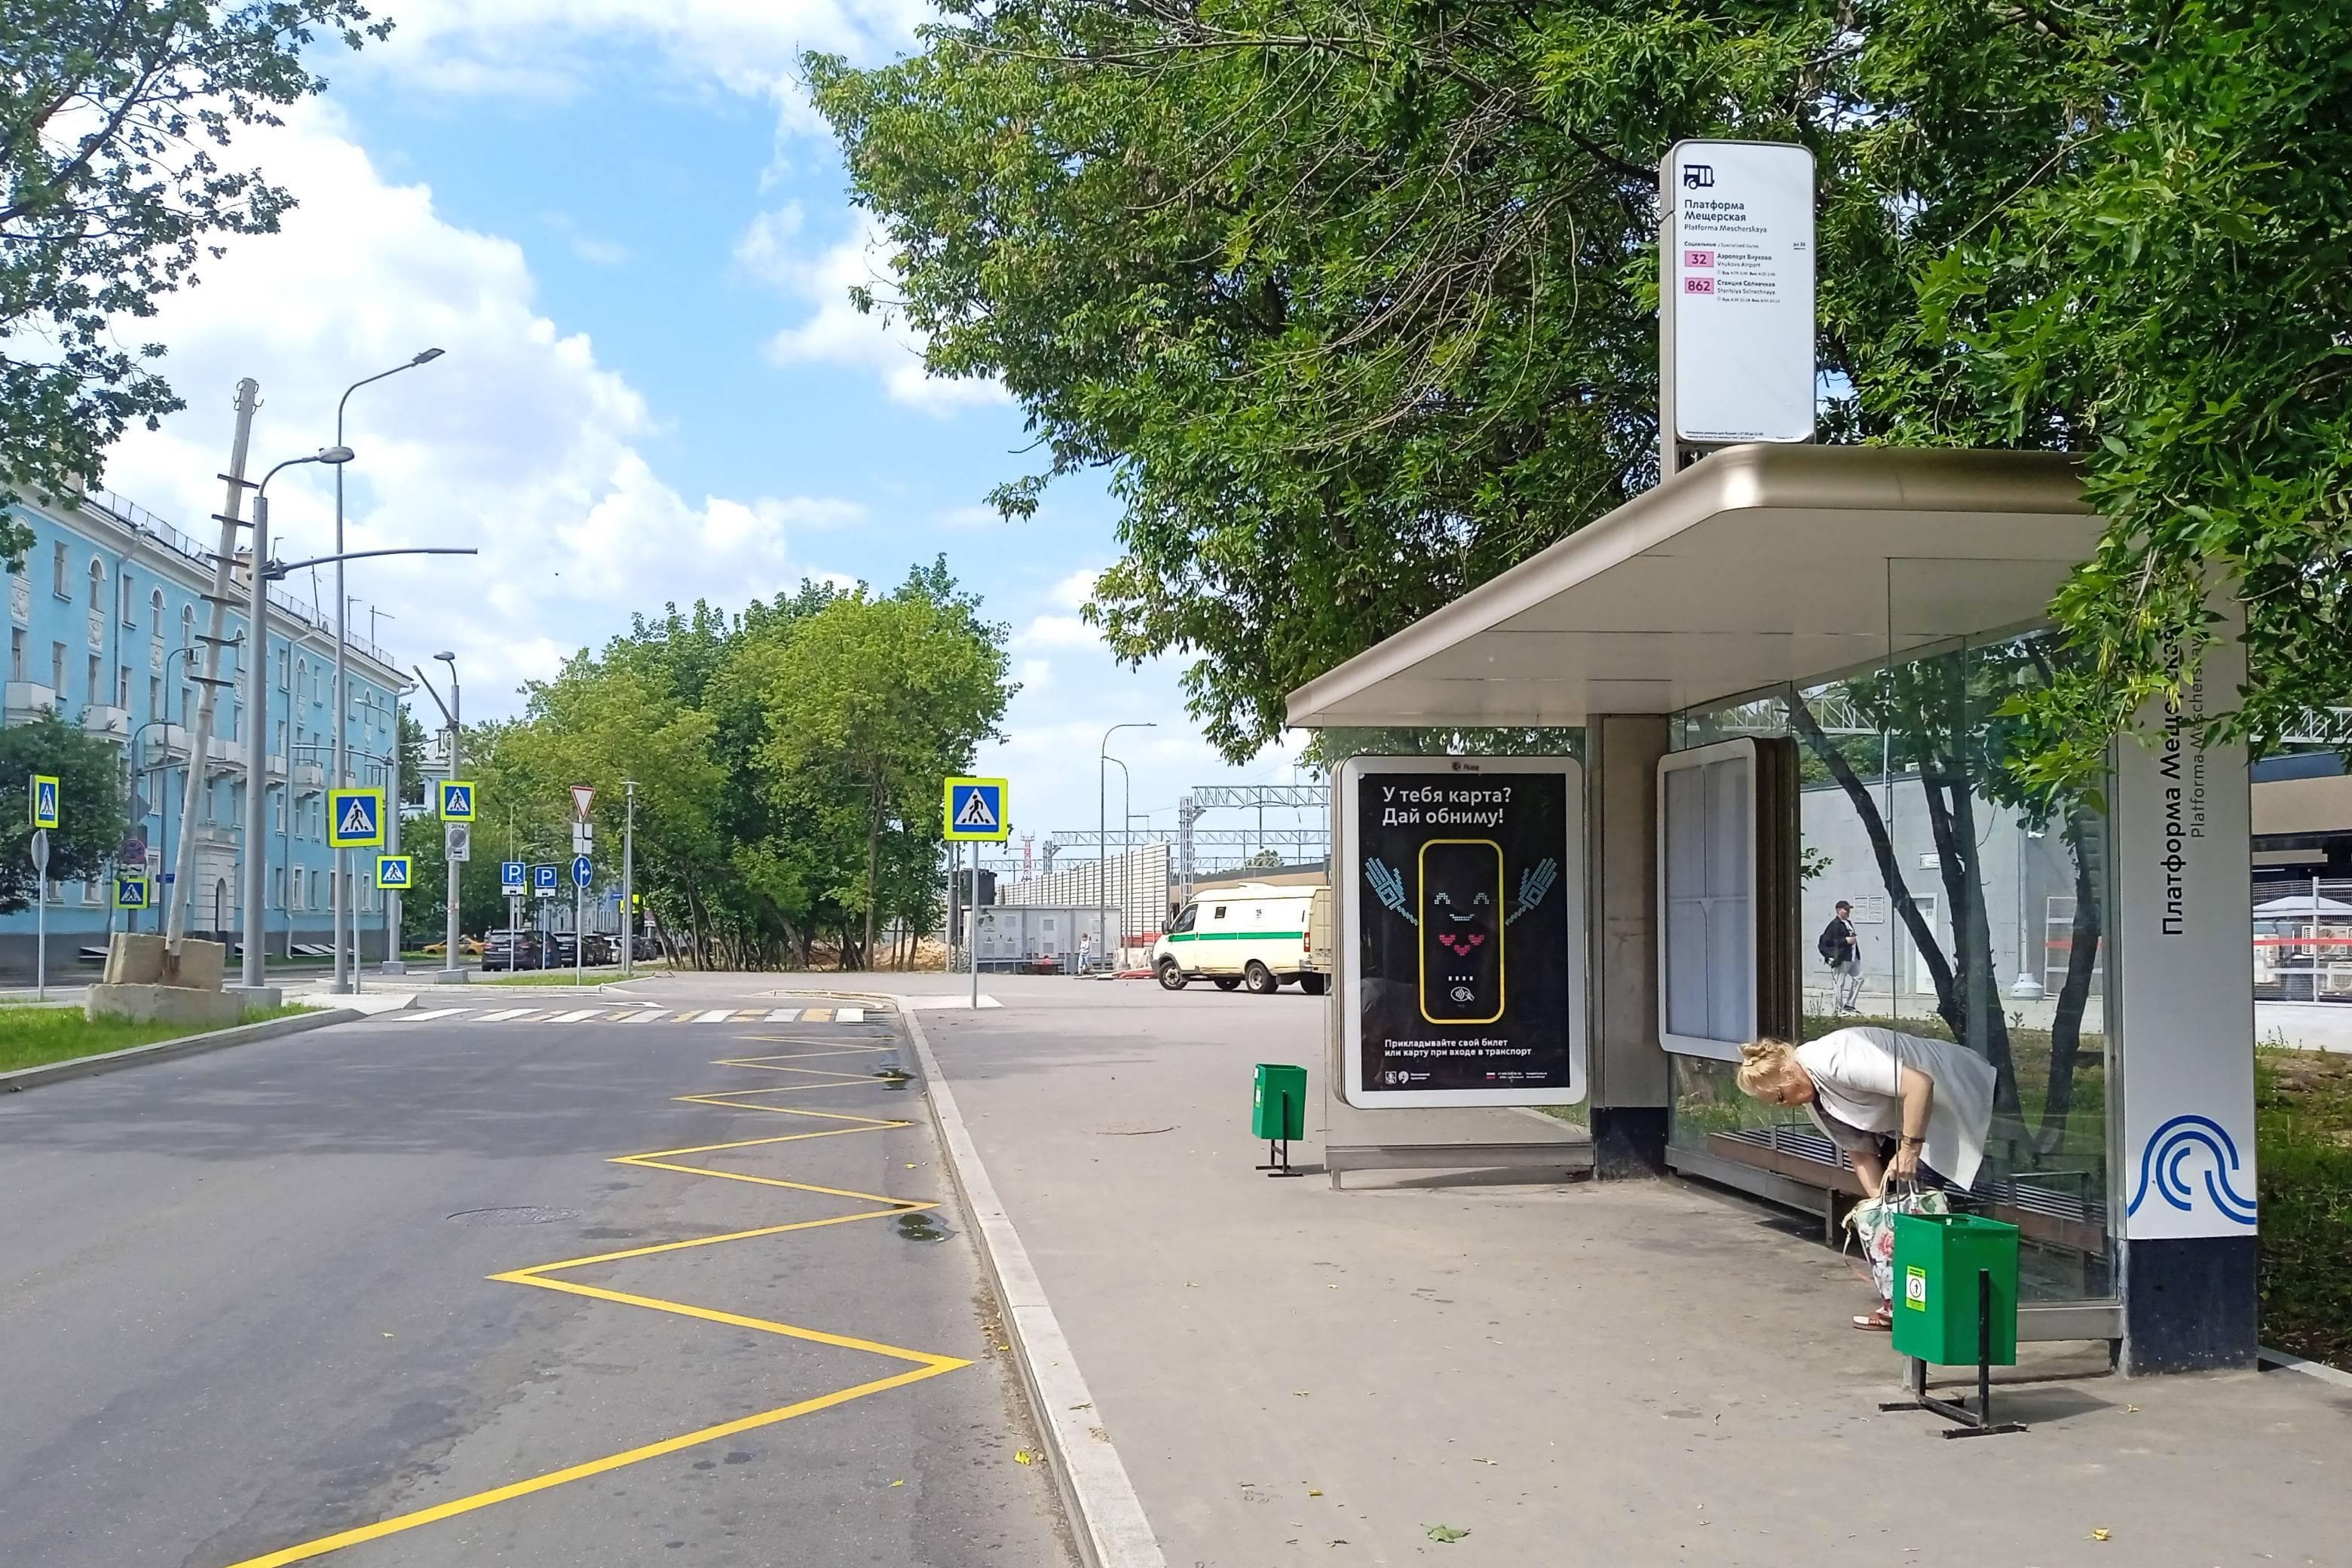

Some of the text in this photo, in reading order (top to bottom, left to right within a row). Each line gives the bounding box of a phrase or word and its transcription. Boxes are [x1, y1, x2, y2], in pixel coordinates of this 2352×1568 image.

[1684, 199, 1744, 211] Платформа
[1684, 211, 1746, 222] Мещерская
[1720, 225, 1767, 234] Mescherskaya
[1692, 253, 1707, 265] 32
[1747, 253, 1772, 262] Внуково
[1688, 280, 1710, 291] 862
[1383, 786, 1511, 806] У тебя карта?
[2191, 755, 2205, 838] Platforma
[1382, 807, 1503, 827] Дай обниму!
[2161, 789, 2186, 936] Платформа
[541, 869, 553, 885] P
[1385, 1039, 1456, 1049] Прикладывайте
[1481, 1038, 1508, 1046] билет
[1403, 1049, 1429, 1058] карту
[1430, 1049, 1447, 1058] при
[1450, 1049, 1476, 1057] входе
[1485, 1049, 1532, 1057] транспорт
